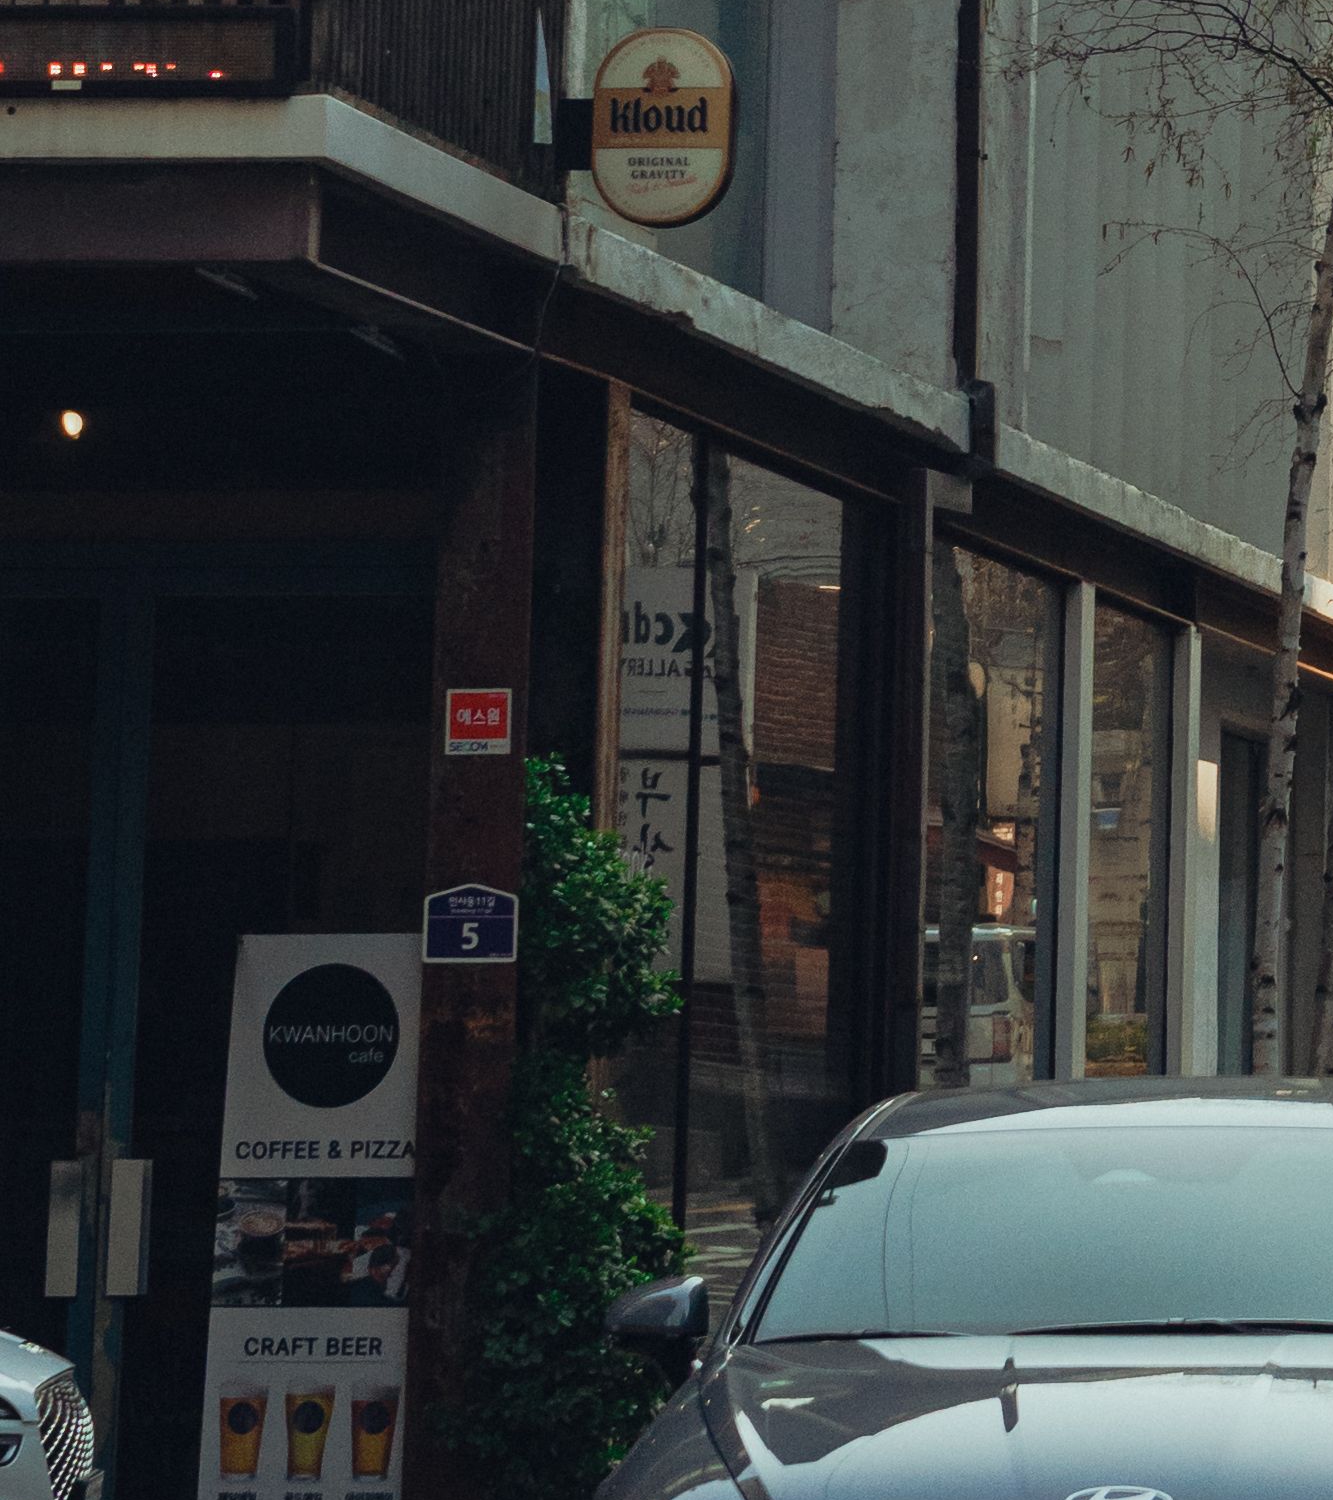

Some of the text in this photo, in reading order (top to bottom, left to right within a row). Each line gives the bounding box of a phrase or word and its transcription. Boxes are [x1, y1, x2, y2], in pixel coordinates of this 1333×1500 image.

[627, 156, 691, 168] ORIGINAL
[630, 169, 687, 180] GRAVITY
[456, 707, 502, 726] 에스원
[460, 921, 480, 951] 5
[268, 1024, 394, 1044] KWANHOON
[348, 1047, 385, 1065] cafe
[235, 1140, 416, 1160] COFFEE & PIZZA
[243, 1336, 383, 1357] CRAFT BEER
